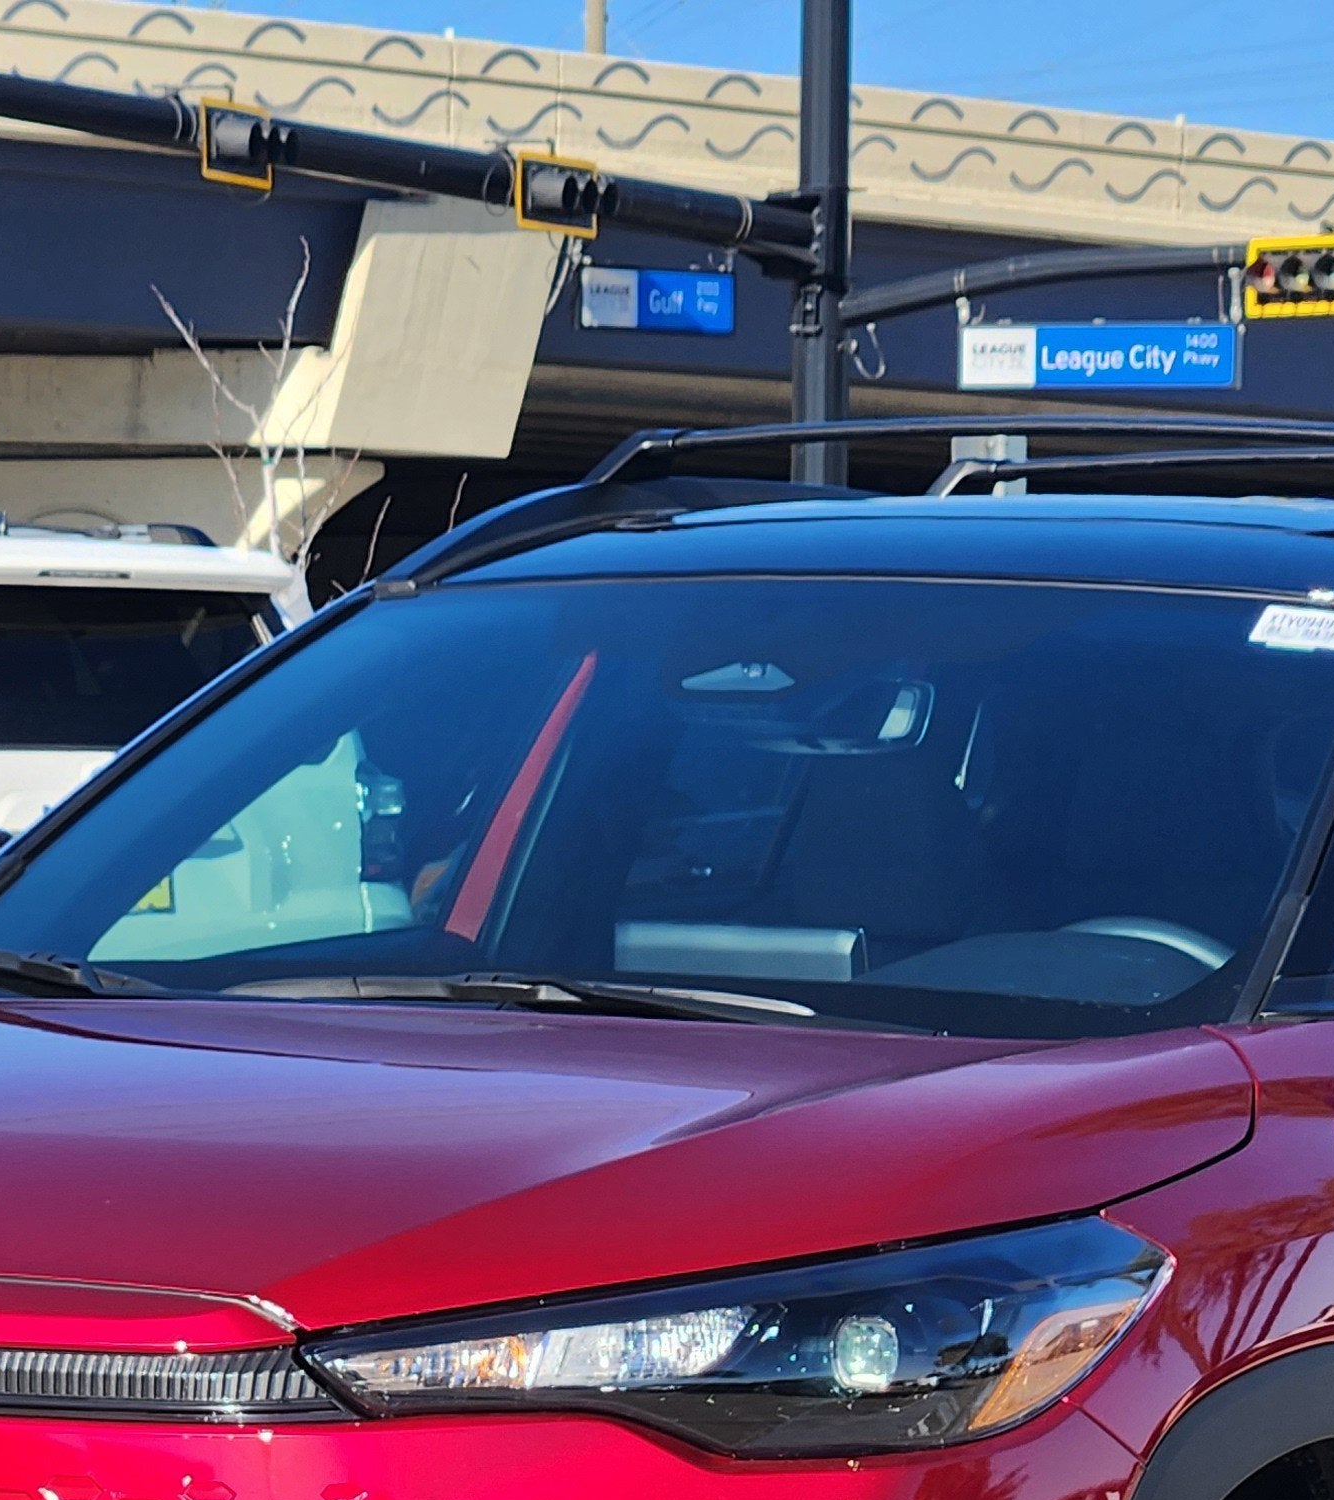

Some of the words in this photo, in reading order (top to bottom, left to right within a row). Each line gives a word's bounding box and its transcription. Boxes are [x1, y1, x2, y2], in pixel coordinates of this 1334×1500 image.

[1185, 332, 1218, 349] 1400
[1040, 346, 1124, 377] League
[1129, 344, 1177, 375] City
